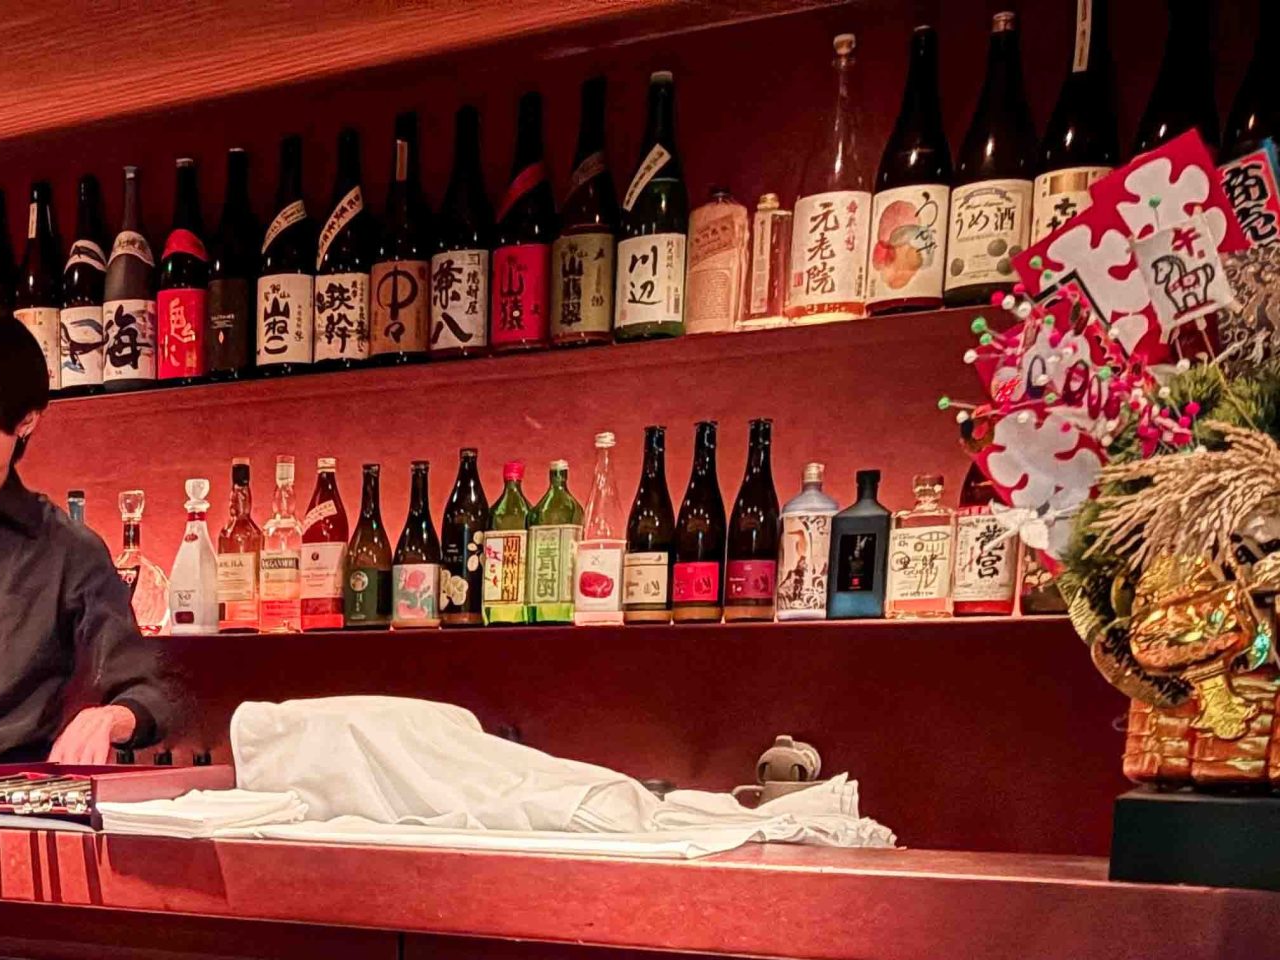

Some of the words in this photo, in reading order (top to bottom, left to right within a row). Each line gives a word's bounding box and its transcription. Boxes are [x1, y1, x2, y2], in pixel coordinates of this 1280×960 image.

[806, 202, 839, 295] 元老院
[955, 206, 1017, 239] うめ酒
[1172, 227, 1201, 257] 午
[432, 259, 473, 344] 兼八
[627, 245, 662, 305] 川辺
[103, 303, 153, 370] 海
[263, 297, 291, 354] 山ねこ
[325, 282, 355, 353] 鉄幹
